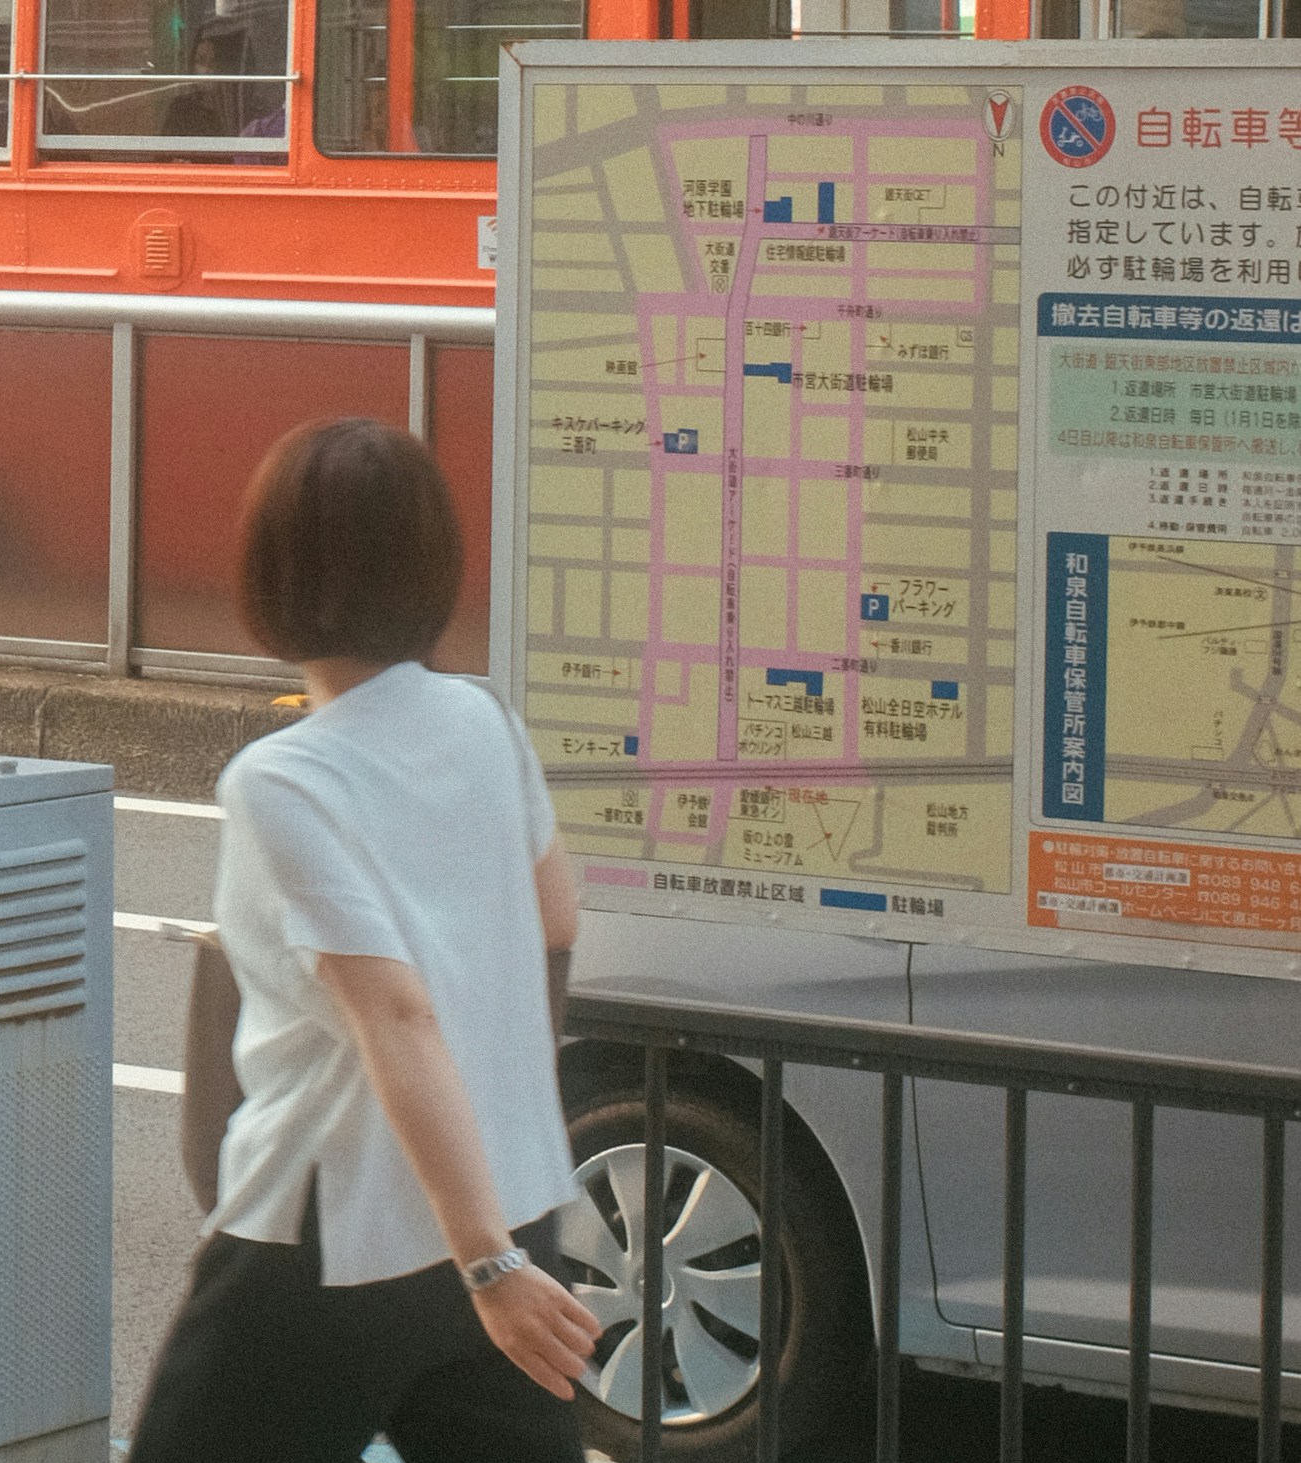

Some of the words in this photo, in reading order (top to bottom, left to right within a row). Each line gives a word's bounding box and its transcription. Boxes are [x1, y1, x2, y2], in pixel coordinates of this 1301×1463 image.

[993, 144, 1004, 157] N
[682, 200, 744, 219] 地下駐輪場
[1069, 184, 1301, 212] この付近は、自転
[1067, 219, 1301, 248] 指定しています。
[705, 243, 734, 257] 大街道
[906, 428, 949, 444] 松山中央
[1062, 553, 1088, 805] 和泉自転車保管所案内図
[862, 697, 963, 720] 松山全日空ホテル
[791, 724, 833, 741] 松山三越
[653, 874, 805, 904] 自転車放置禁止区域
[891, 894, 945, 917] 駐輪場
